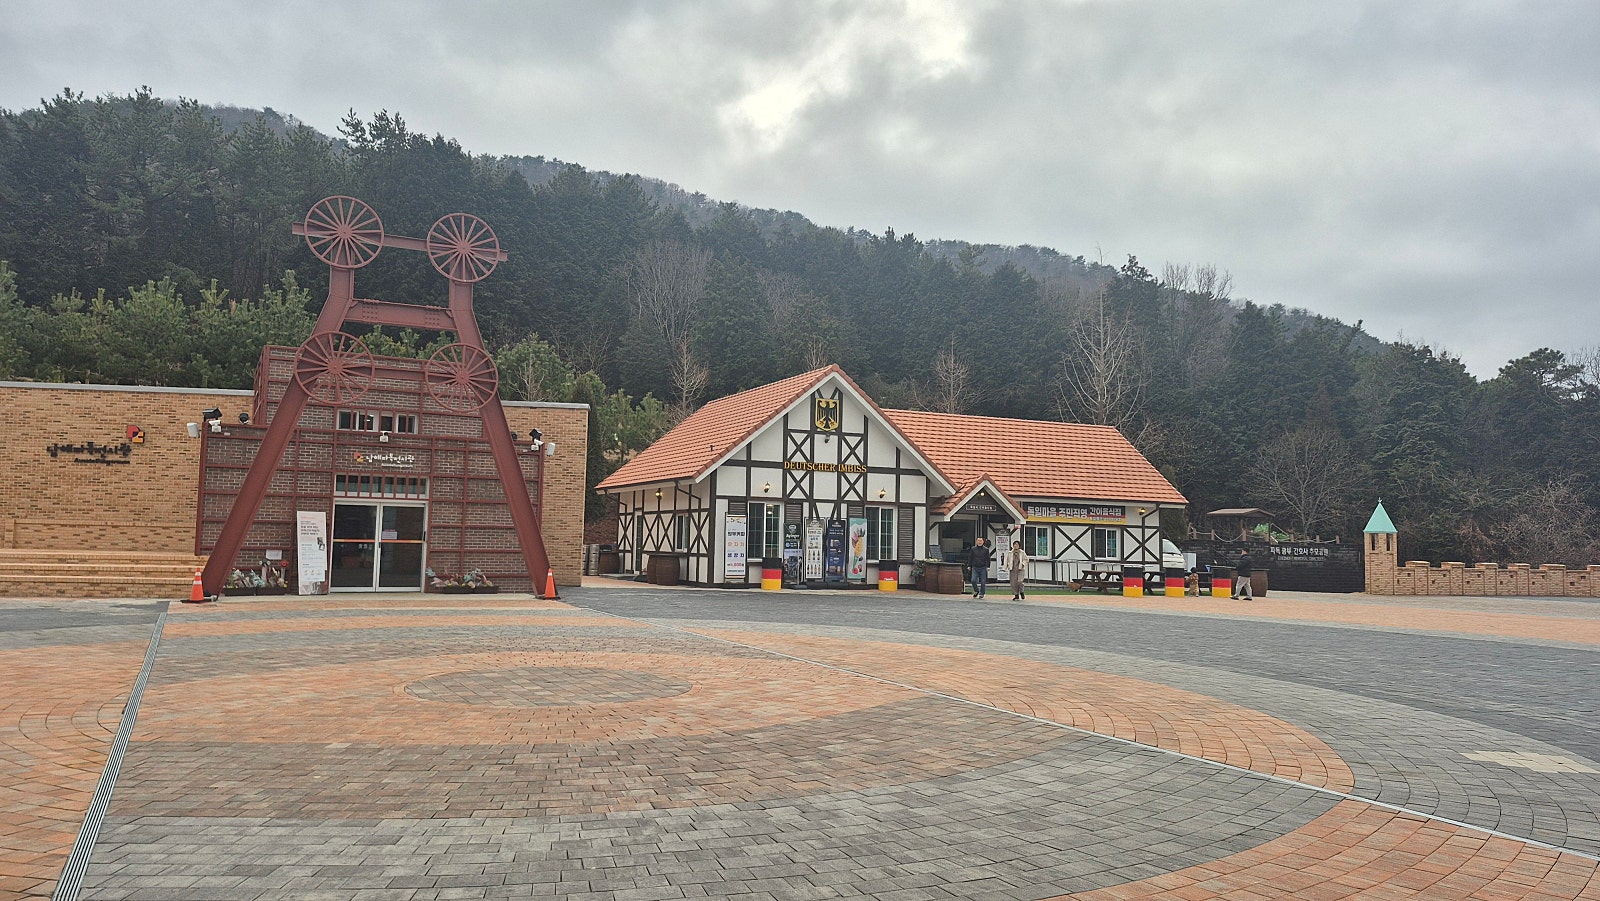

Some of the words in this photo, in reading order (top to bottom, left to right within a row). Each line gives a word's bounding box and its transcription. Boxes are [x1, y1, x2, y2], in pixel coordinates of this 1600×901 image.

[784, 461, 836, 473] DEUTSCHER
[838, 464, 867, 473] IMBISS
[1027, 506, 1057, 518] 독일마을
[1059, 507, 1088, 520] 주민직영
[1090, 507, 1121, 516] 간이음식점
[1270, 546, 1281, 555] 파독
[1293, 547, 1309, 556] 간호사
